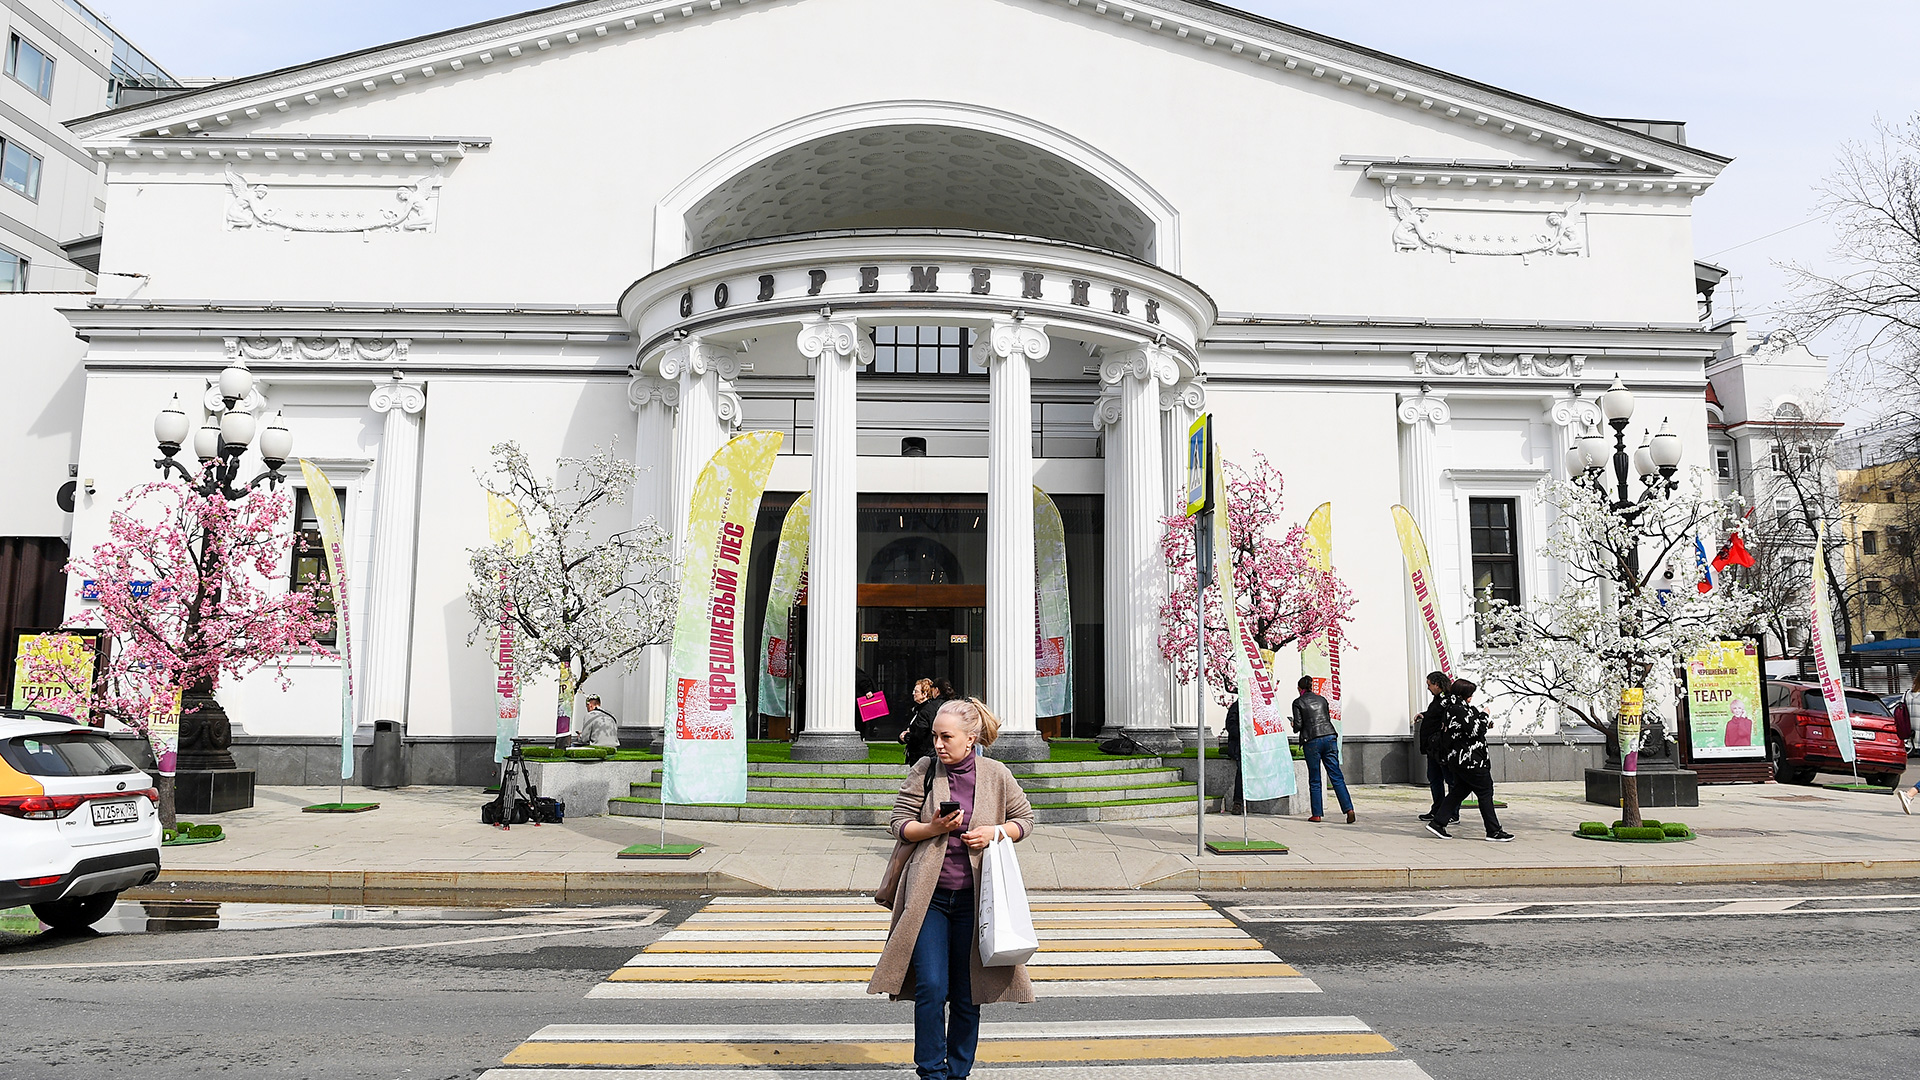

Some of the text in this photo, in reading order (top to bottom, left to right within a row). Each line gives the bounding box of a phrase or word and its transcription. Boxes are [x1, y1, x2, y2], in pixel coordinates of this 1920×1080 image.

[680, 266, 1160, 325] СОВРЕМЕННИК
[706, 486, 733, 621] ОТКРЫТЫЙ ФЕСТИВАЛЬ ИСКУССТВ
[709, 521, 745, 712] ЧЕРЕШНЕВЫЙ ЛЕС
[21, 686, 62, 699] ТЕАТР
[1693, 689, 1733, 702] ТЕАТР
[676, 706, 684, 739] СЕЗОН
